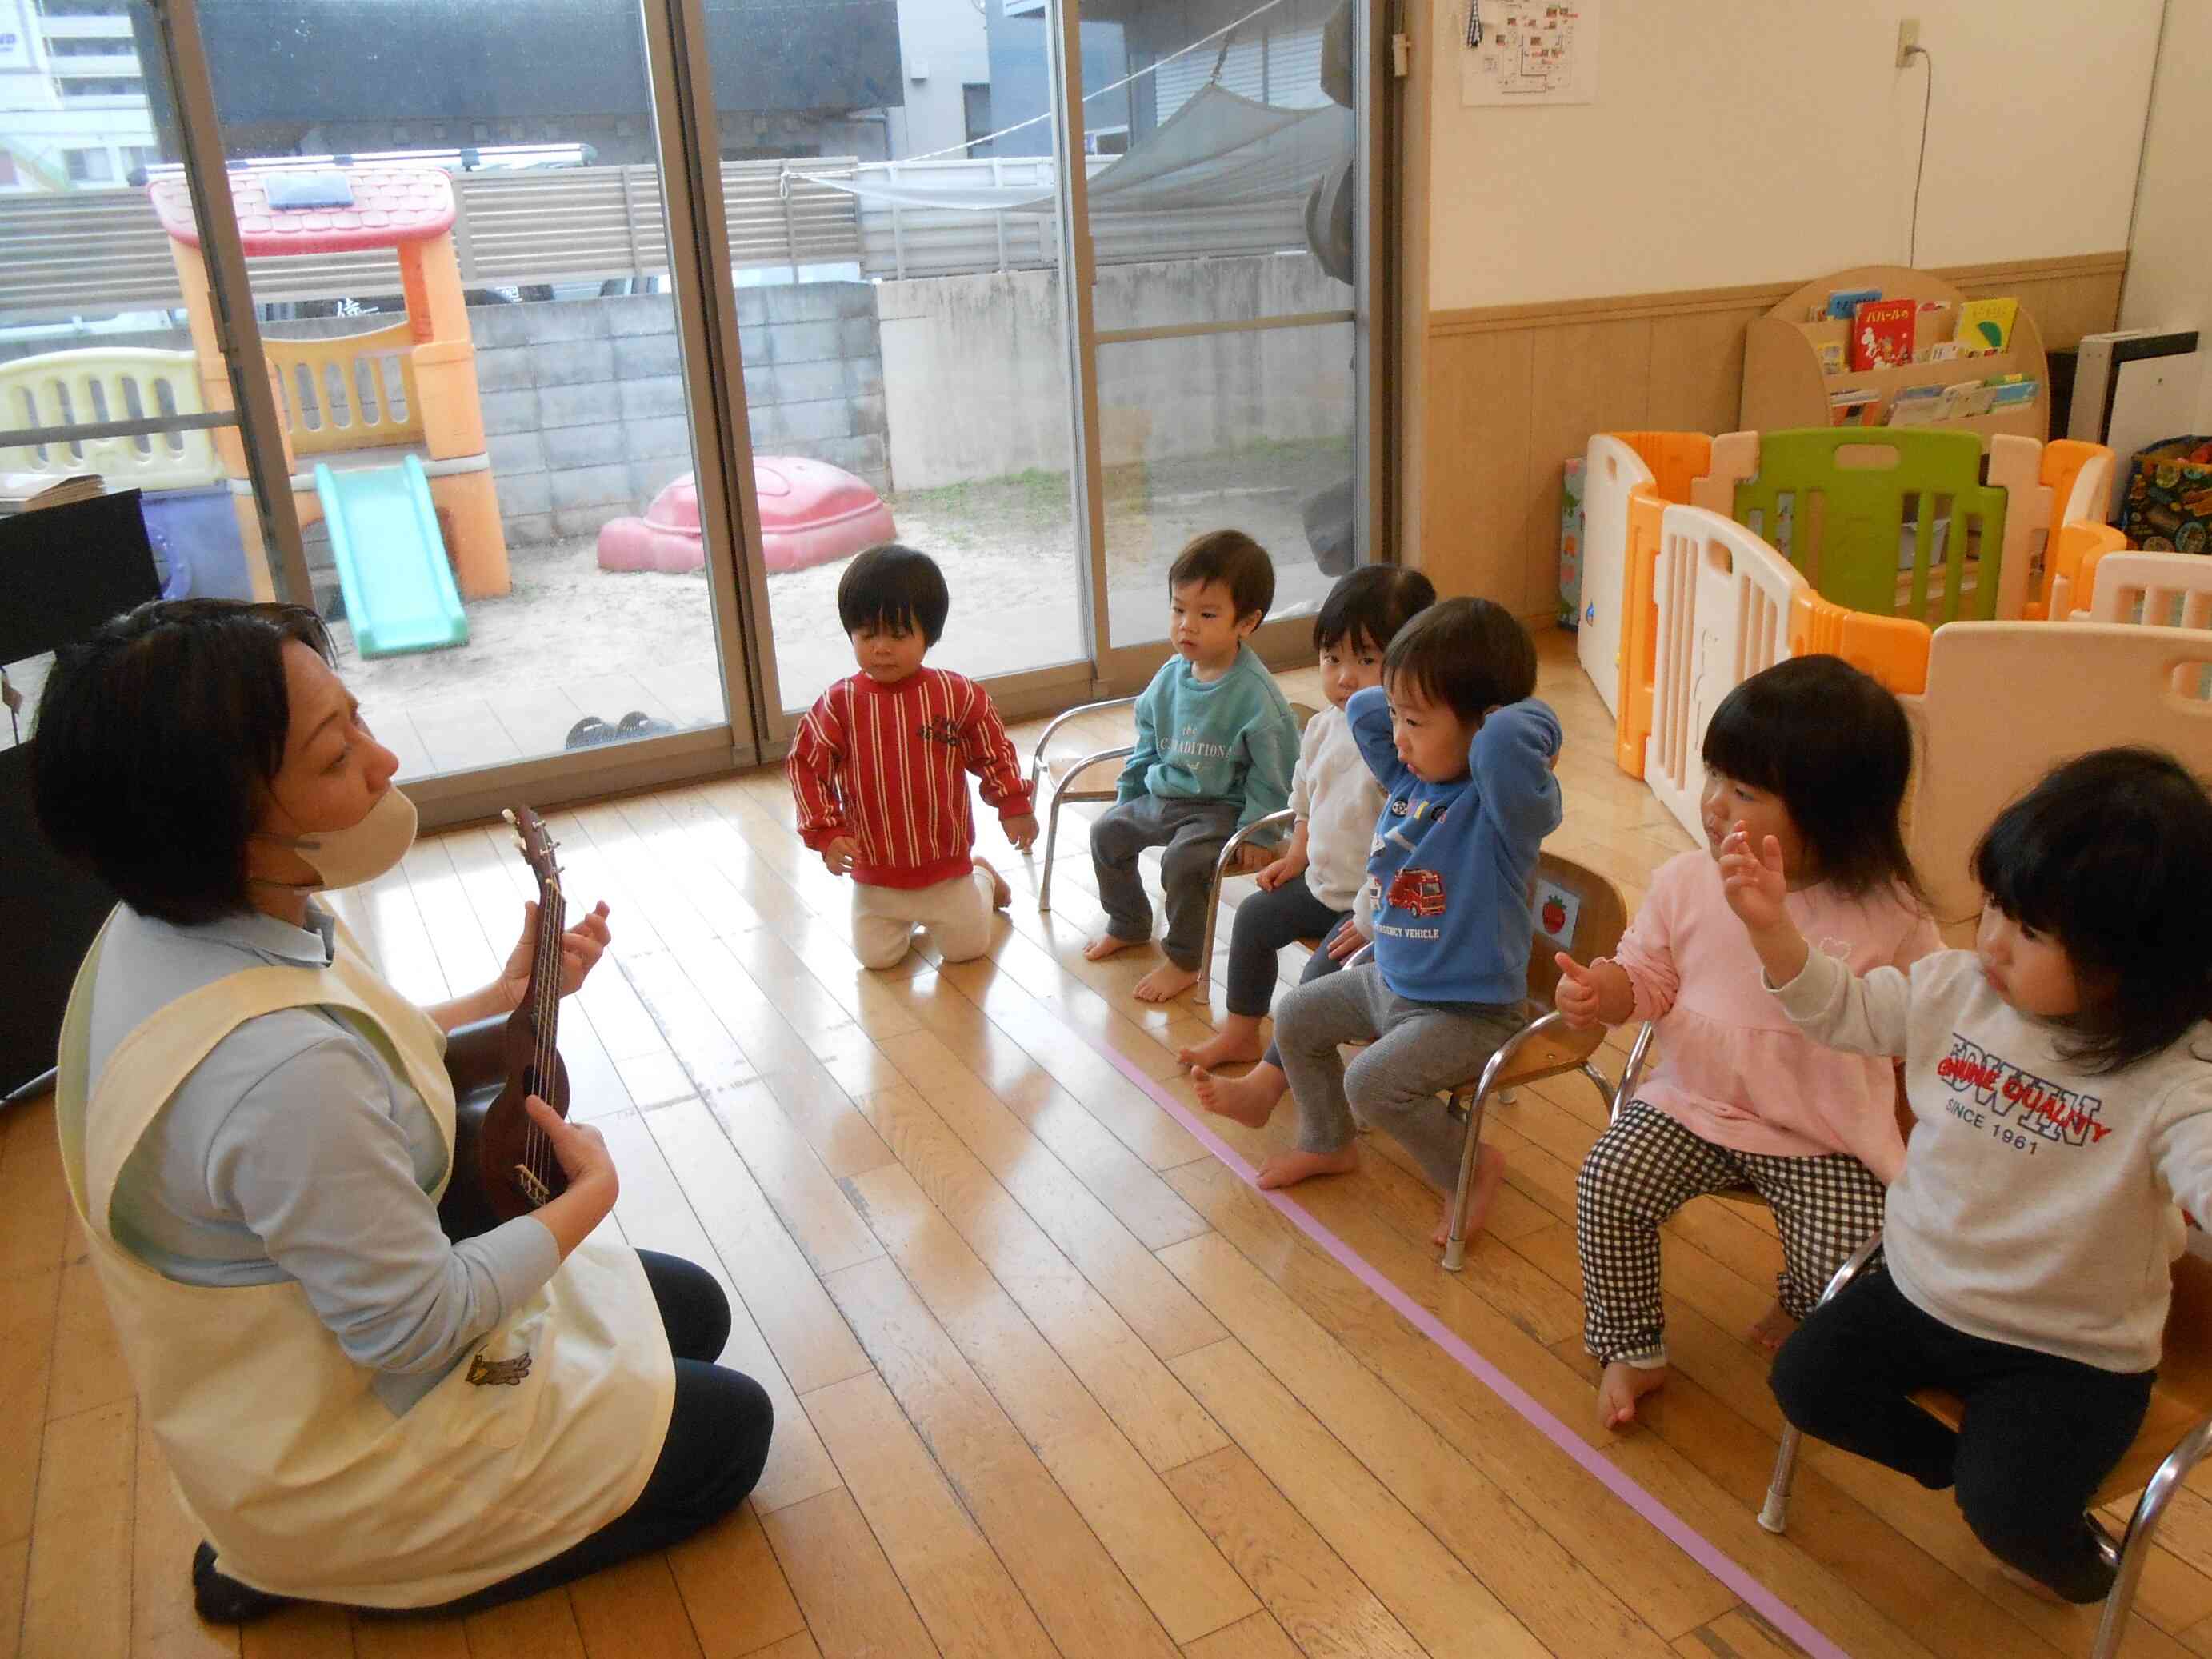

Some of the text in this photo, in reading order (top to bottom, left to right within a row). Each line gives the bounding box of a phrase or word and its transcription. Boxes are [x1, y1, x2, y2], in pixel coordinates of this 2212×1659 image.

[1405, 927, 1440, 939] VEHICLE
[1945, 1097, 2038, 1155] SINCE 1961
